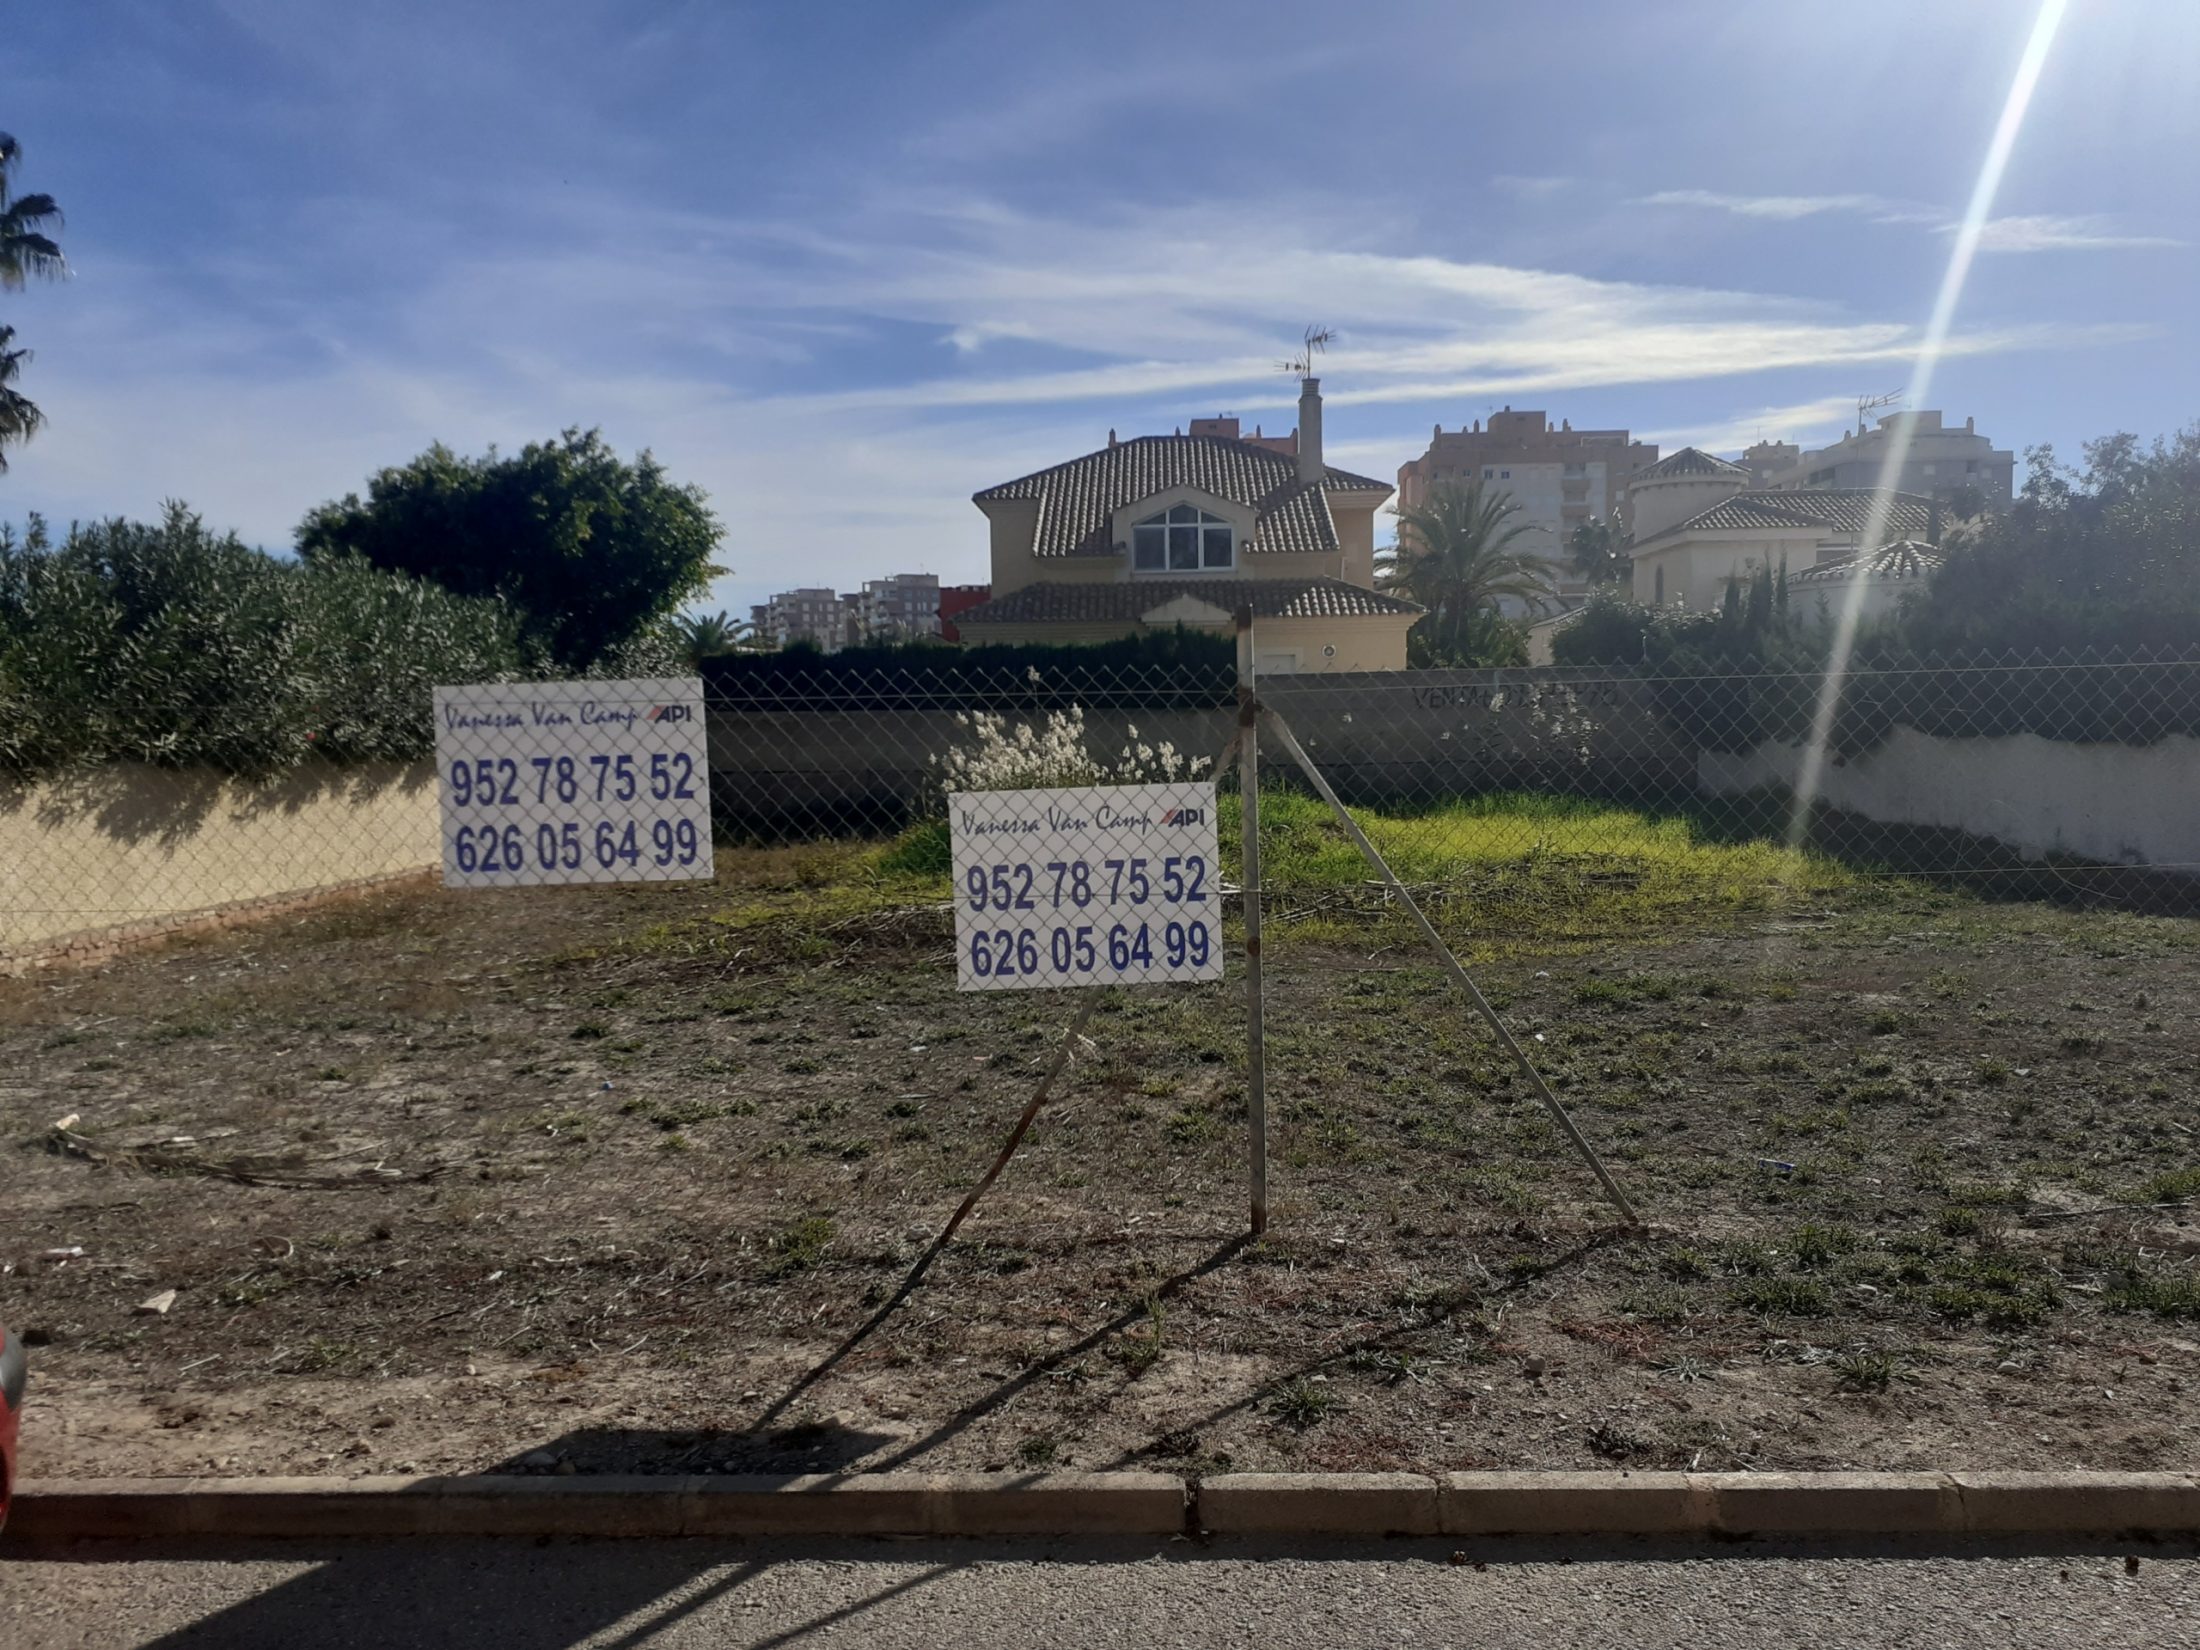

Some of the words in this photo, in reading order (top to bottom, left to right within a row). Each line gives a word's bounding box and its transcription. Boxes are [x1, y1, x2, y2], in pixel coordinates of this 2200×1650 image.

[445, 703, 523, 729] Vanessa
[532, 702, 572, 725] Van
[580, 701, 637, 730] Camp
[654, 705, 691, 723] API
[451, 758, 519, 807] 952
[532, 756, 577, 804] 78
[590, 754, 636, 801] 75
[651, 752, 695, 801] 52
[456, 824, 524, 872] 626
[537, 822, 581, 870] 05
[596, 820, 640, 868] 64
[653, 818, 697, 866] 99
[962, 810, 1040, 836] Vanessa
[1049, 806, 1088, 830] Van
[1096, 805, 1152, 835] Camp
[1168, 808, 1205, 827] API
[966, 863, 1034, 911] 952
[1047, 861, 1092, 907] 78
[1105, 858, 1149, 905] 75
[1164, 856, 1207, 903] 52
[971, 928, 1038, 977] 626
[1051, 926, 1095, 973] 05
[1109, 923, 1153, 971] 64
[1166, 921, 1209, 967] 99
